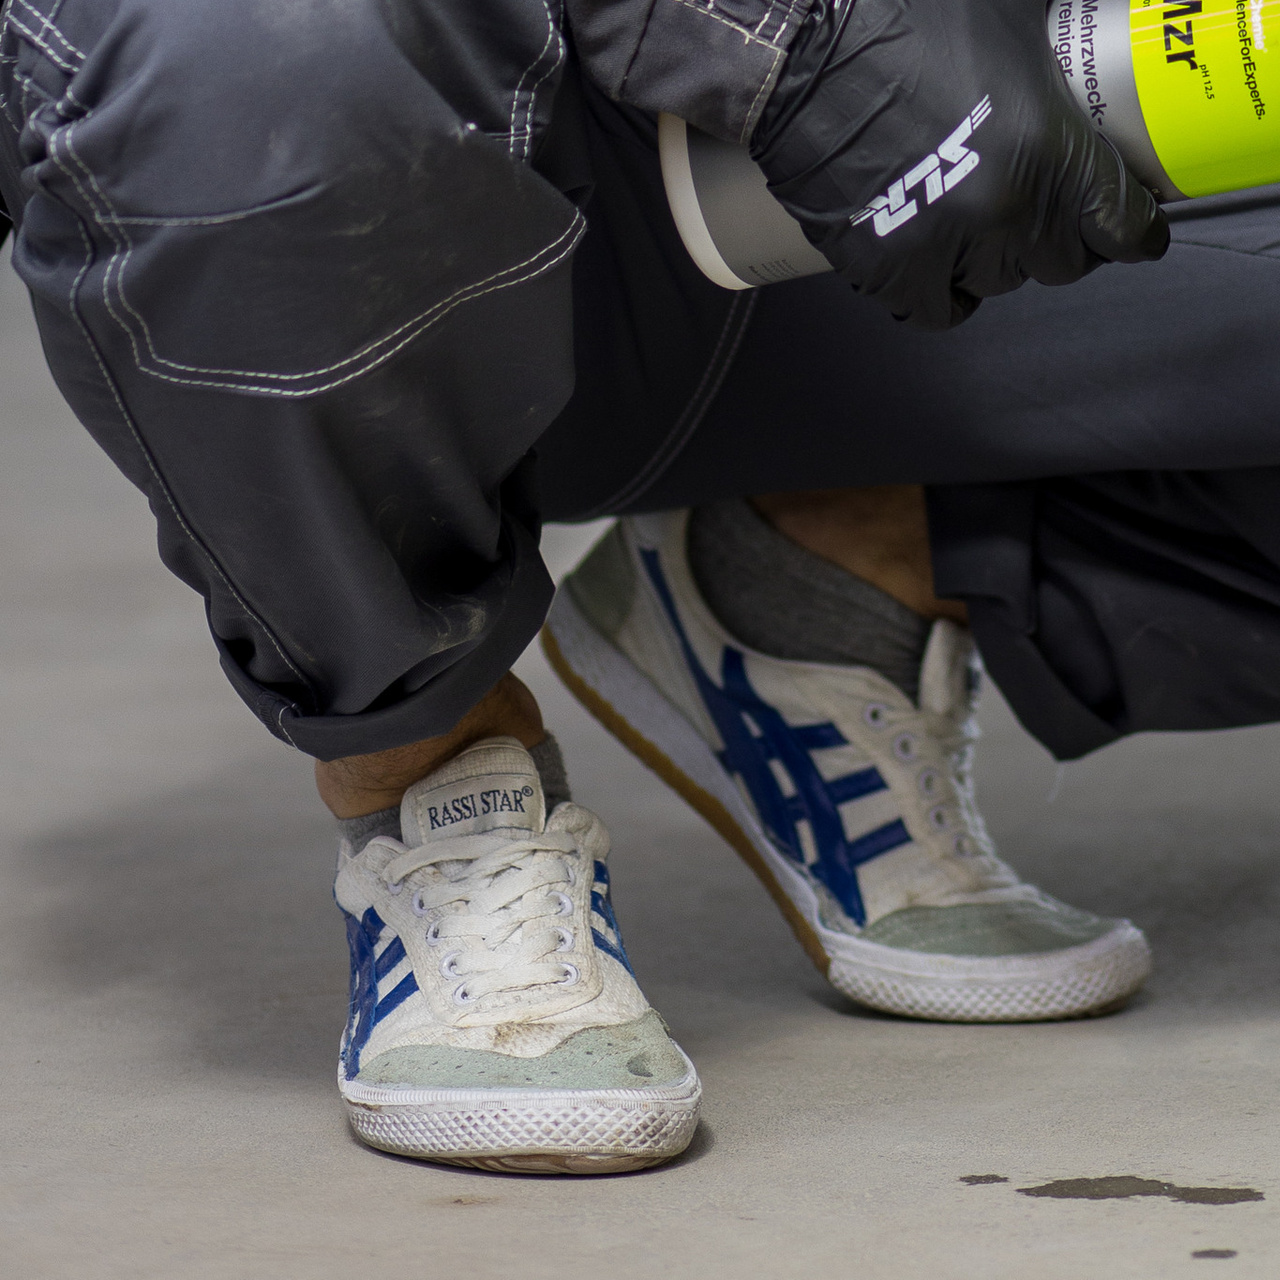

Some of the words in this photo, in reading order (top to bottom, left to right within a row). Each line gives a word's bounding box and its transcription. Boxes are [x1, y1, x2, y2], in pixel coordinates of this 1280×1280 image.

[1054, 1, 1074, 78] reiniger
[1199, 64, 1210, 79] pH
[1203, 81, 1215, 100] 12,5
[427, 794, 479, 831] RASSI
